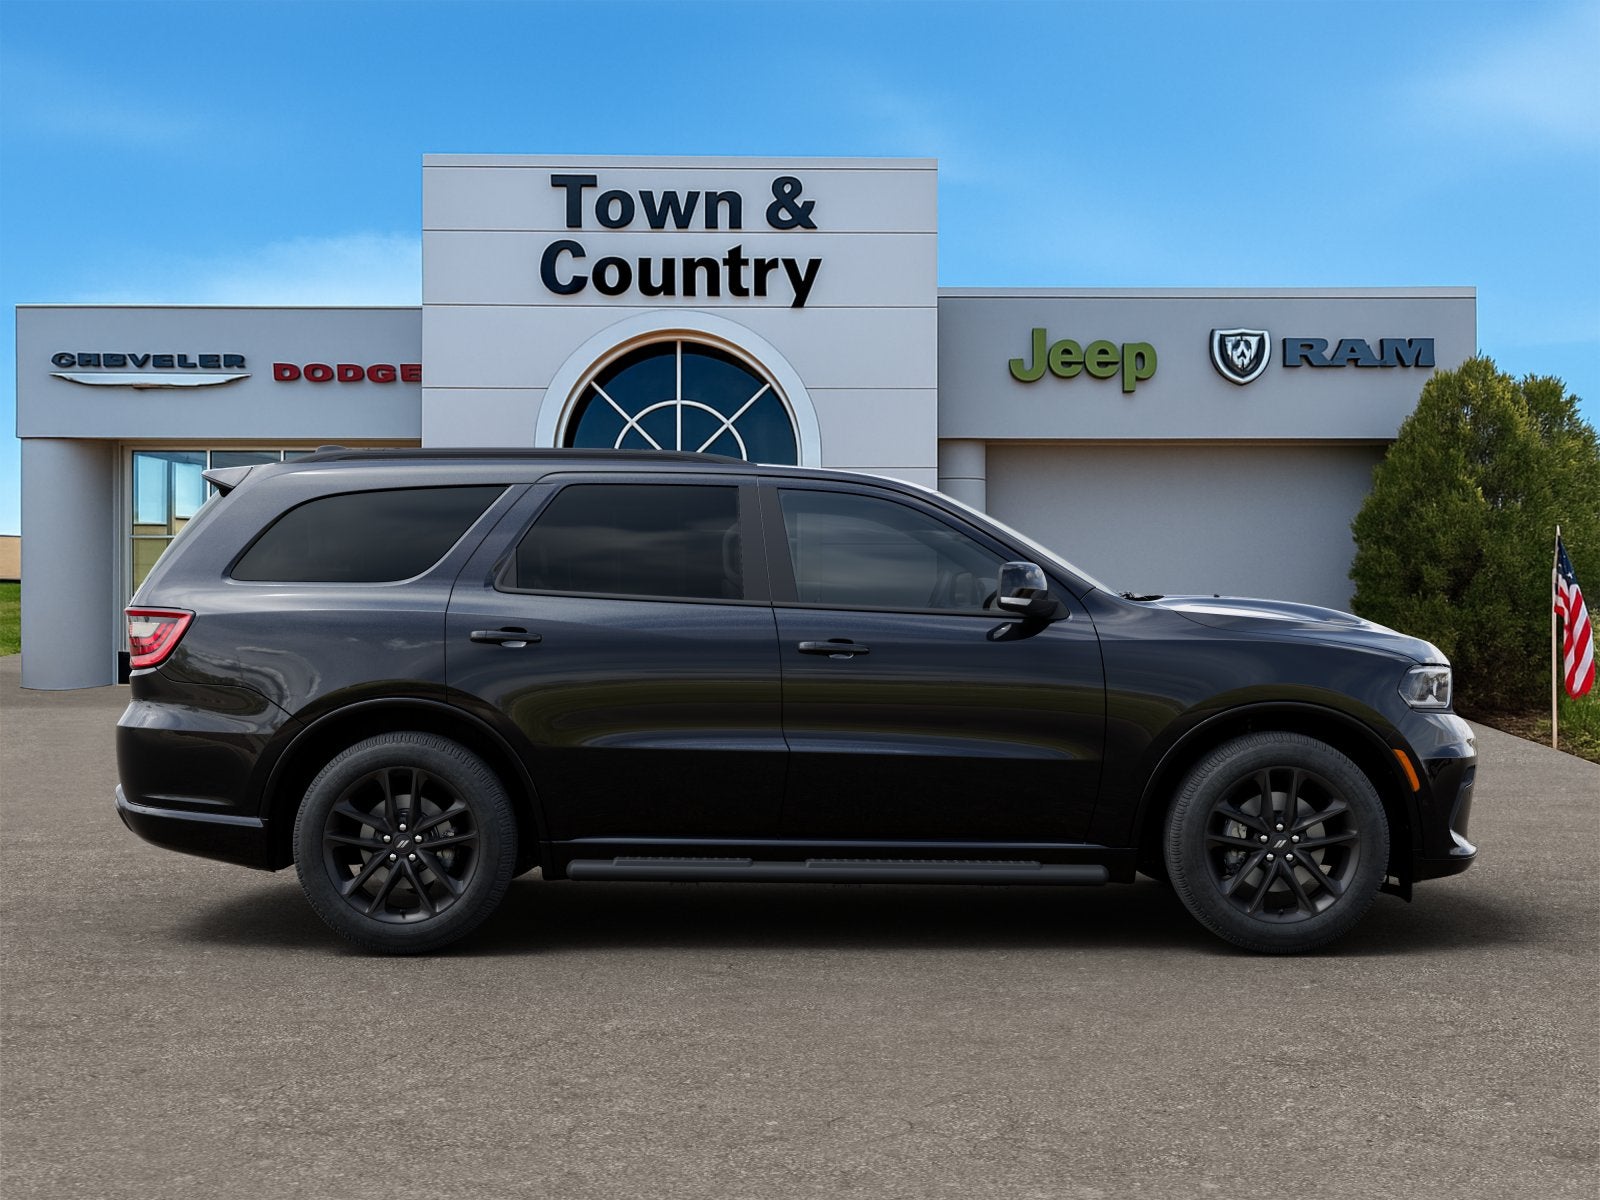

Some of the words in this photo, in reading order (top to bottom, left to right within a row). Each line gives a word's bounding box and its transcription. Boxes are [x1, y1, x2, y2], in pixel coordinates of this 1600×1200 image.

[551, 174, 742, 229] Town
[766, 176, 818, 230] &
[540, 239, 822, 308] Country
[273, 363, 422, 383] DODGE
[1009, 328, 1158, 393] Jeep
[1282, 338, 1436, 368] RAM
